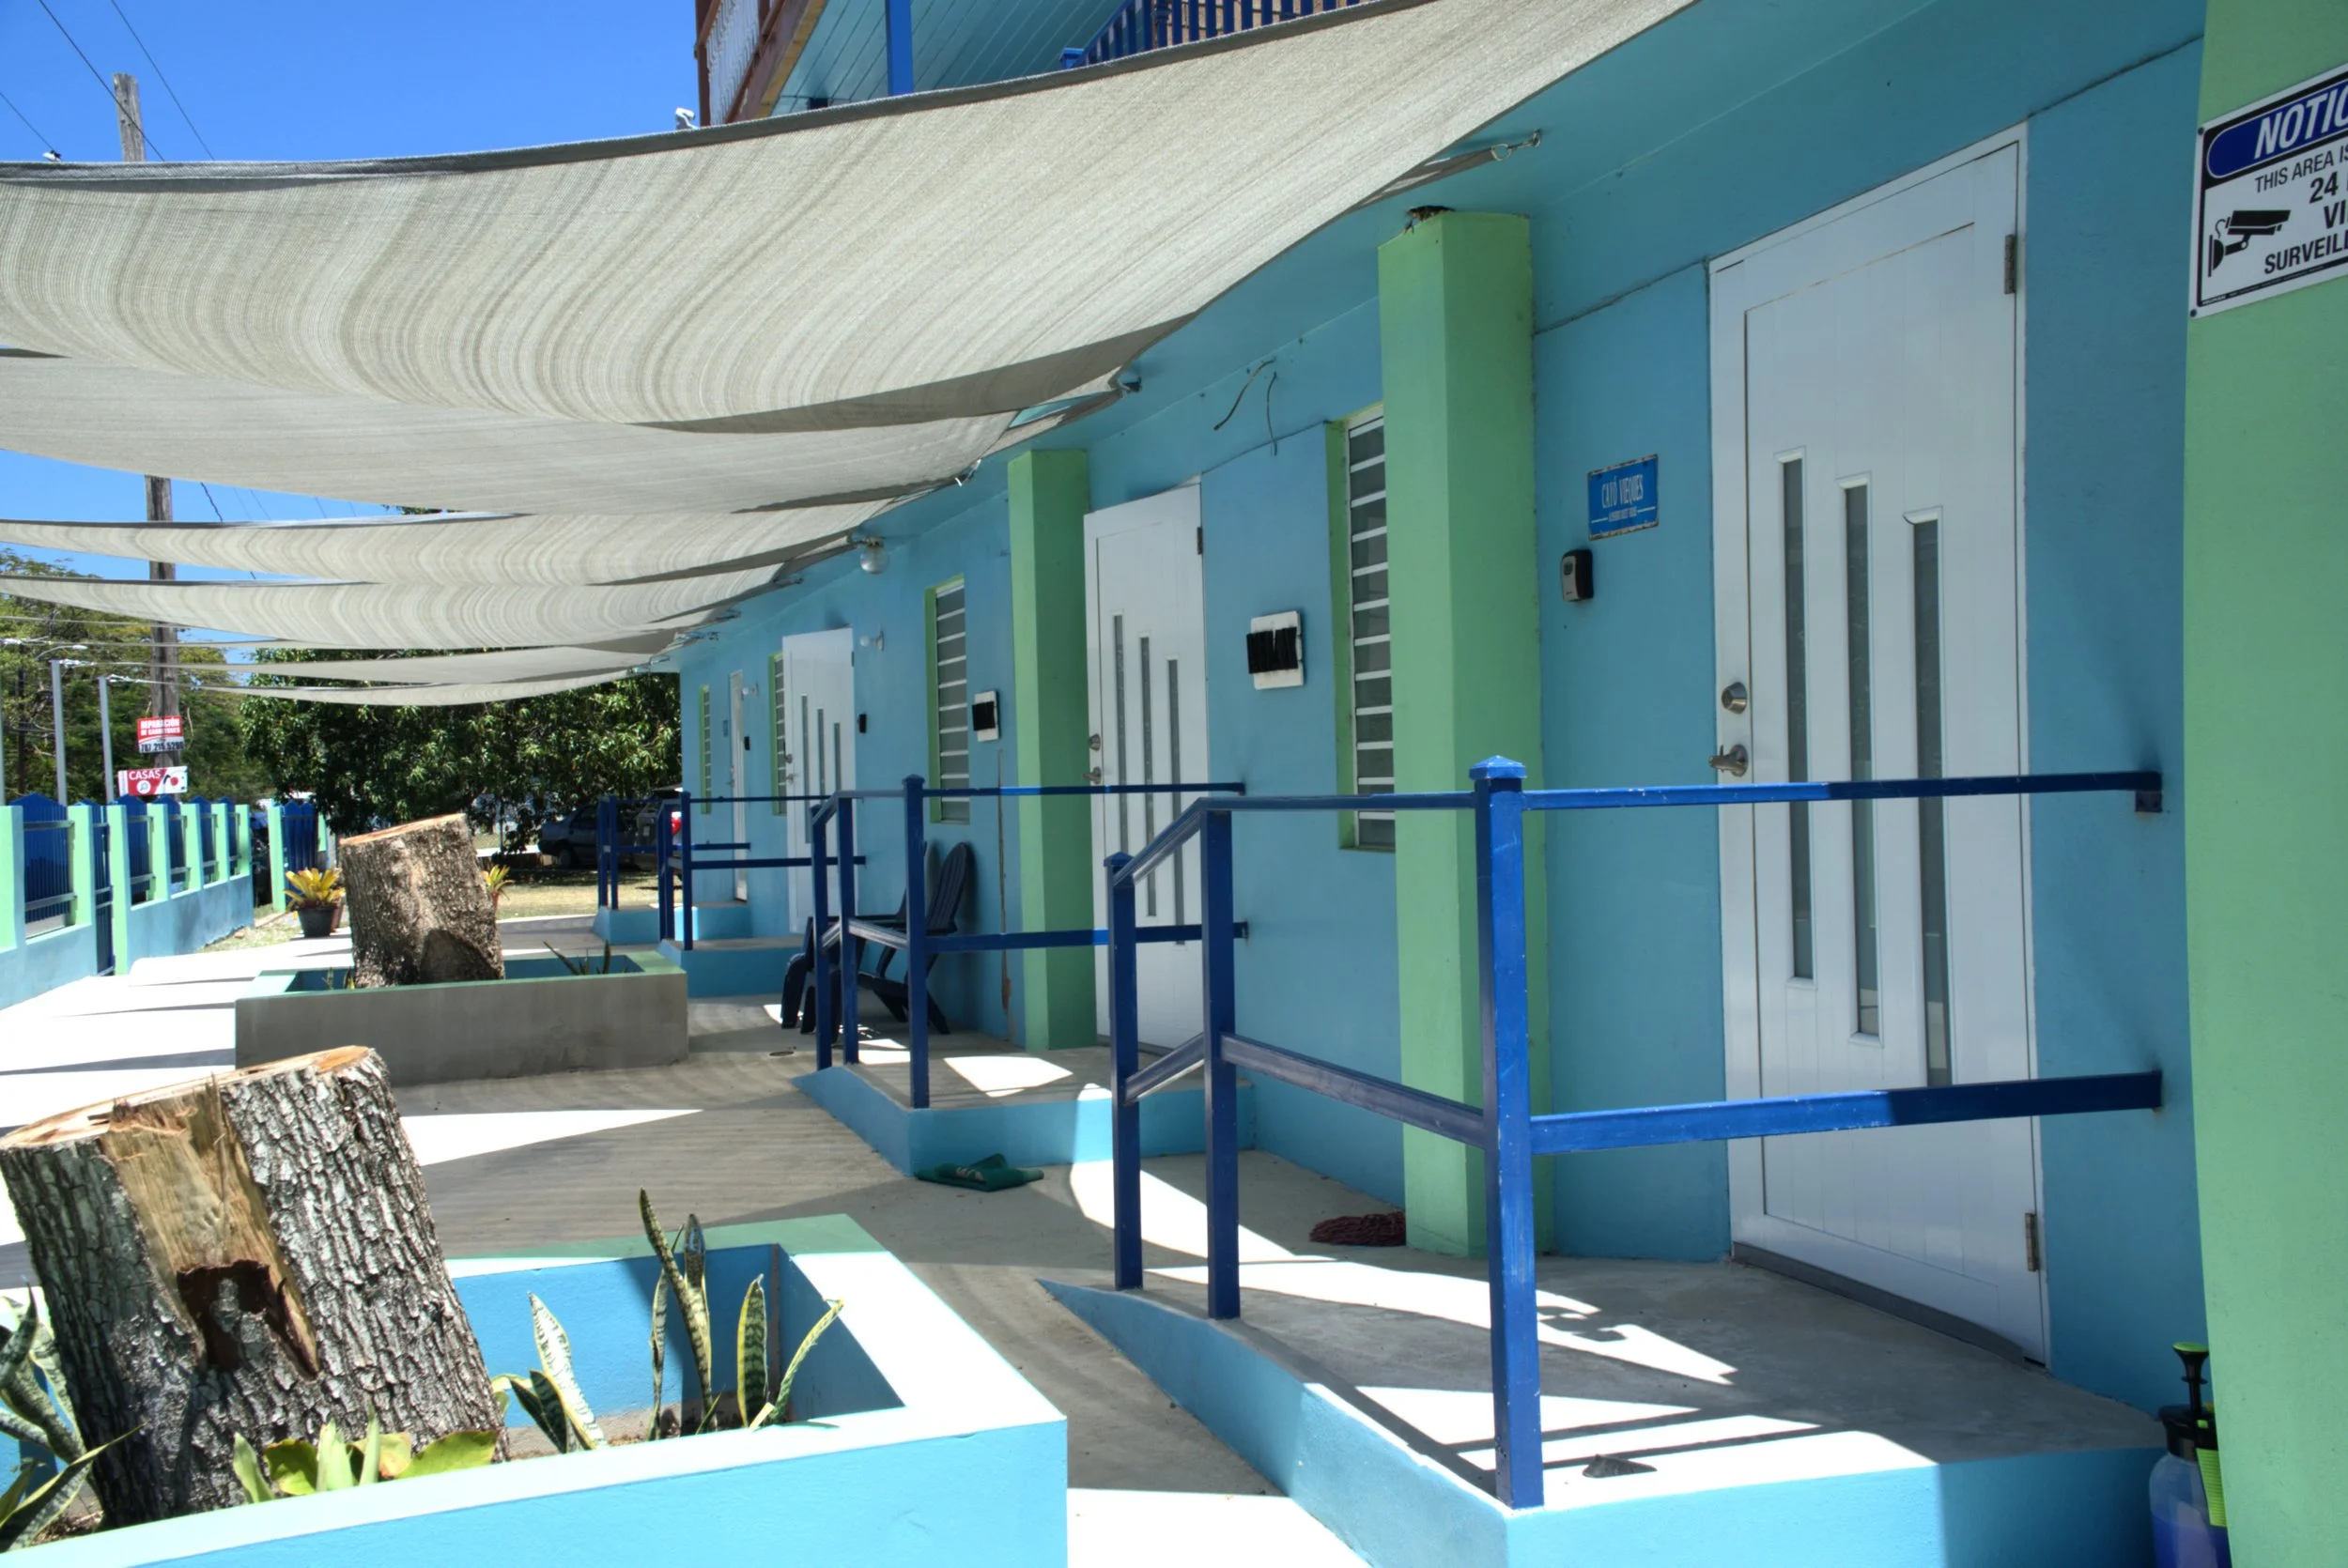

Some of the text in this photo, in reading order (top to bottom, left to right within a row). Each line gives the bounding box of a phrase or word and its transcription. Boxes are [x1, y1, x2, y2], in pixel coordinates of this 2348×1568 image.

[2255, 167, 2288, 194] THIS
[2292, 150, 2334, 181] AREA
[2309, 171, 2339, 204] 24
[2324, 199, 2348, 229] VI
[129, 770, 162, 780] CASAS
